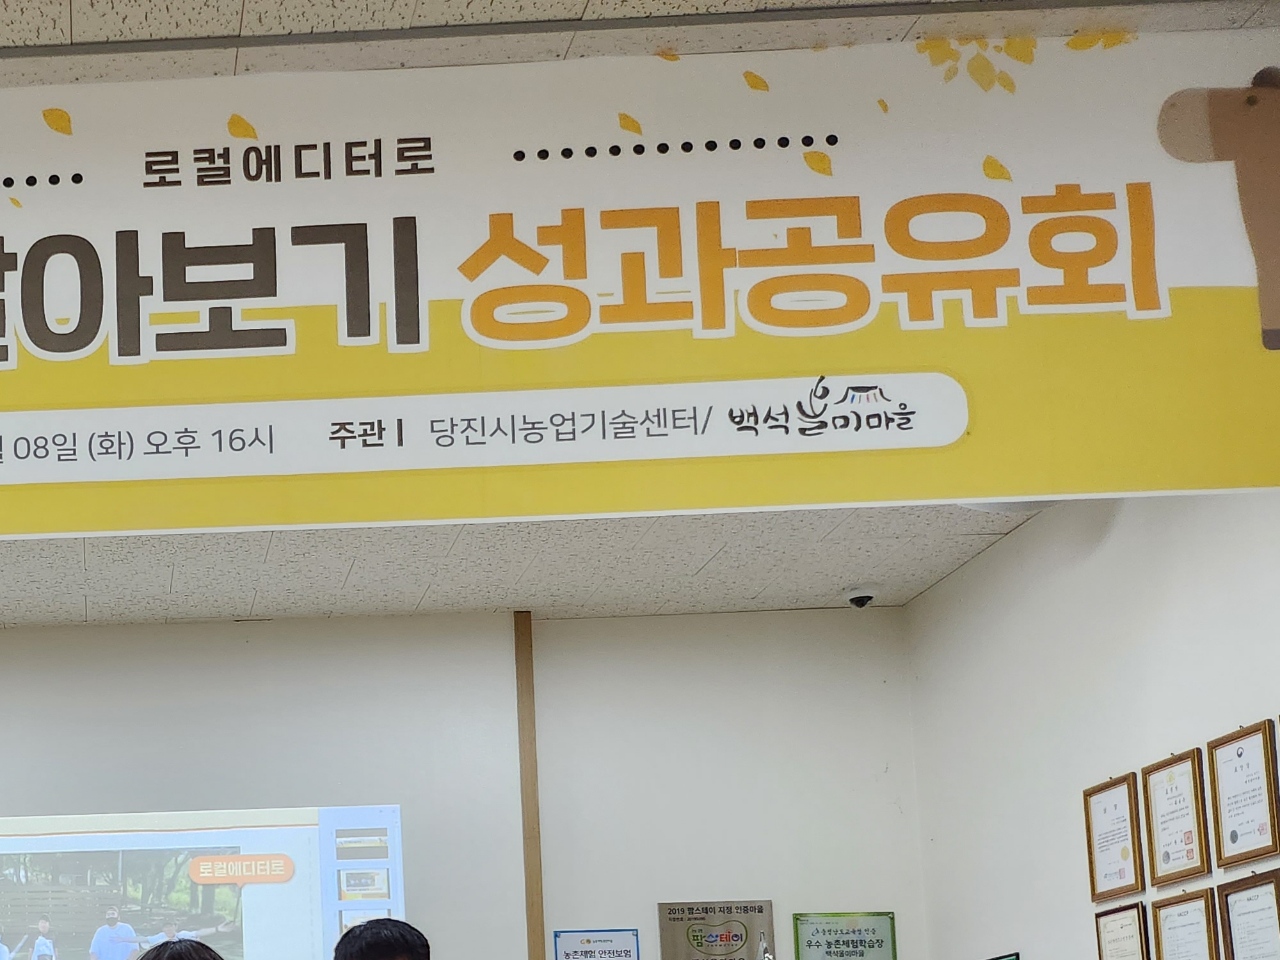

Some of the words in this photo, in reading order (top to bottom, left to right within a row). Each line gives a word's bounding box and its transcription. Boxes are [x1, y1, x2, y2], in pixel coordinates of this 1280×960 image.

[142, 135, 436, 188] 로컬에디터로
[457, 182, 1163, 342] 성과공유회
[12, 432, 78, 463] 08일
[87, 430, 134, 462] (화)
[143, 427, 202, 457] 오후
[211, 424, 274, 454] 16시
[199, 860, 285, 877] 로컬에디터로
[668, 907, 685, 915] 2019
[687, 906, 716, 915] 팜스테이
[718, 905, 733, 914] 지정
[735, 905, 764, 914] 인증마을
[691, 930, 743, 948] 팜스테이
[806, 940, 822, 949] 우수
[824, 938, 884, 949] 농촌체험학습장
[563, 949, 596, 960] 농촌체험
[598, 949, 632, 959] 안전보험
